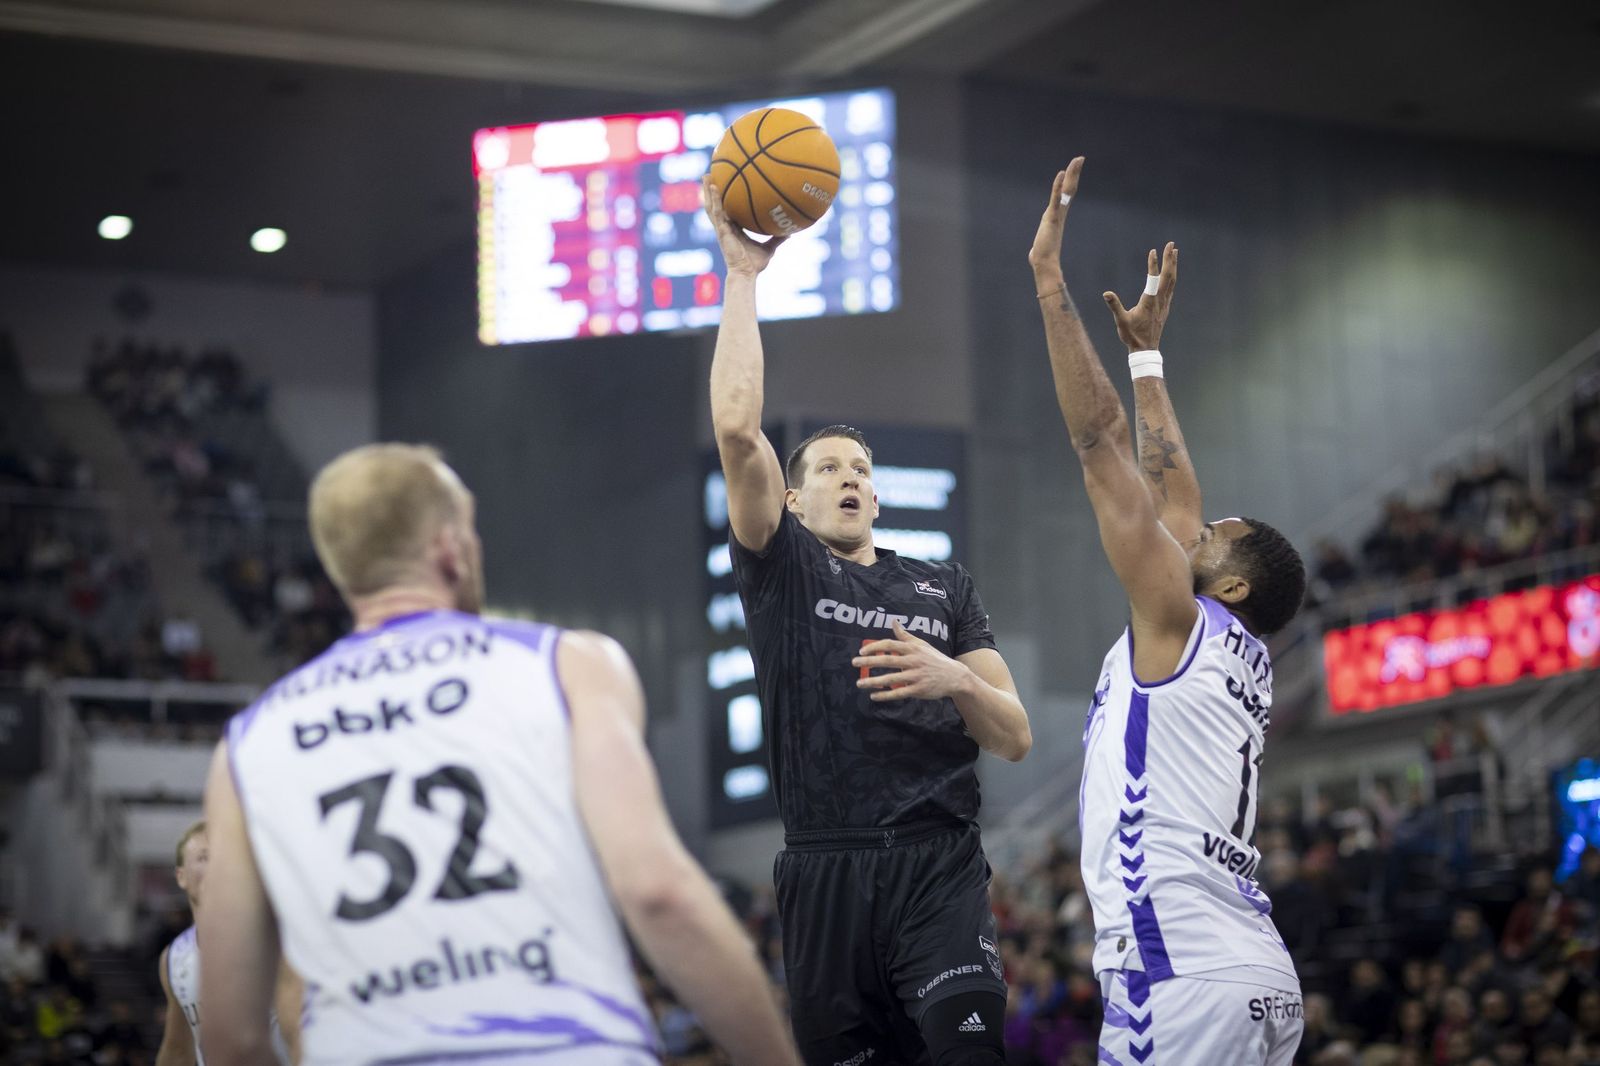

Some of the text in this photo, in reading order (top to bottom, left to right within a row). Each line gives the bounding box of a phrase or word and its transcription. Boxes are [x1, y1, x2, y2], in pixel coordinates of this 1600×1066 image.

[317, 764, 521, 923] 32
[926, 964, 983, 992] BERNER
[958, 1024, 986, 1032] adidas
